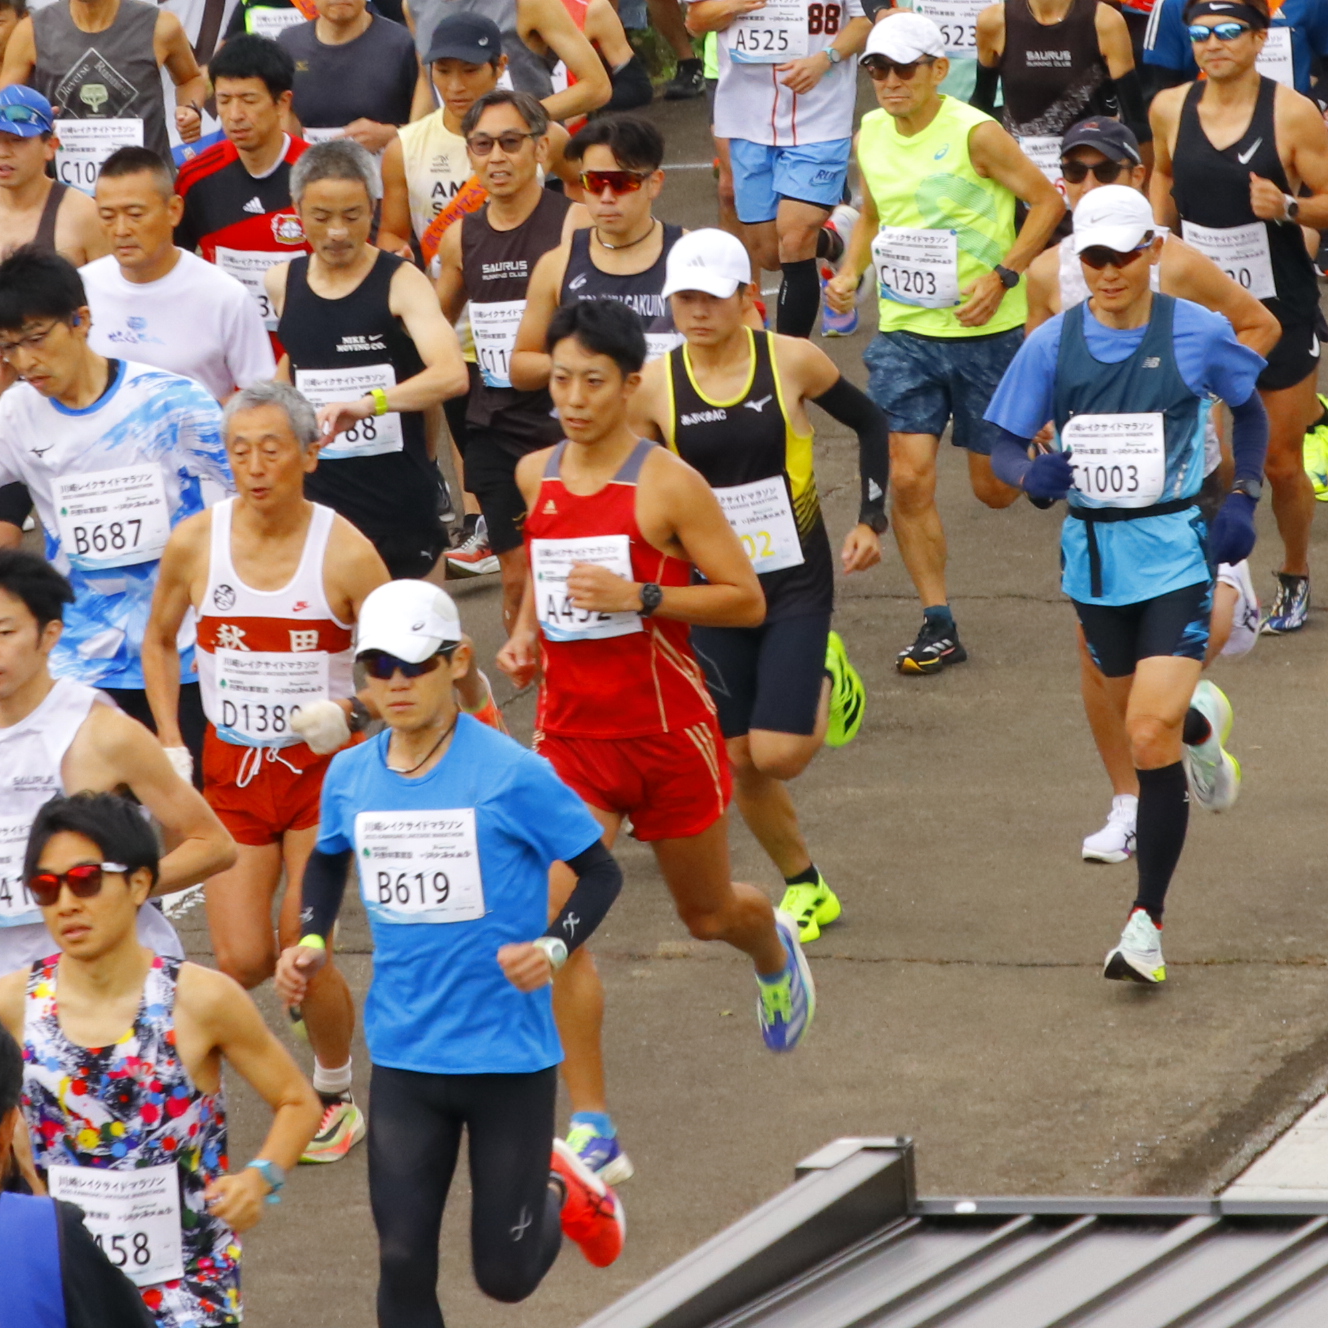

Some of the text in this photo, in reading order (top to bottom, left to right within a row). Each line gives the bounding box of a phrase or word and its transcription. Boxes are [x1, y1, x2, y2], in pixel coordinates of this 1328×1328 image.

[808, 3, 841, 35] 88
[736, 29, 789, 51] A525
[938, 25, 976, 47] 623
[1025, 50, 1072, 61] SAURUS
[60, 161, 104, 184] C10
[481, 260, 528, 274] SAURUS
[880, 265, 937, 295] C1203
[480, 348, 509, 374] C11
[1071, 464, 1139, 493] C1003
[74, 519, 142, 554] B687
[216, 623, 319, 653] 秋田
[377, 871, 450, 904] B619
